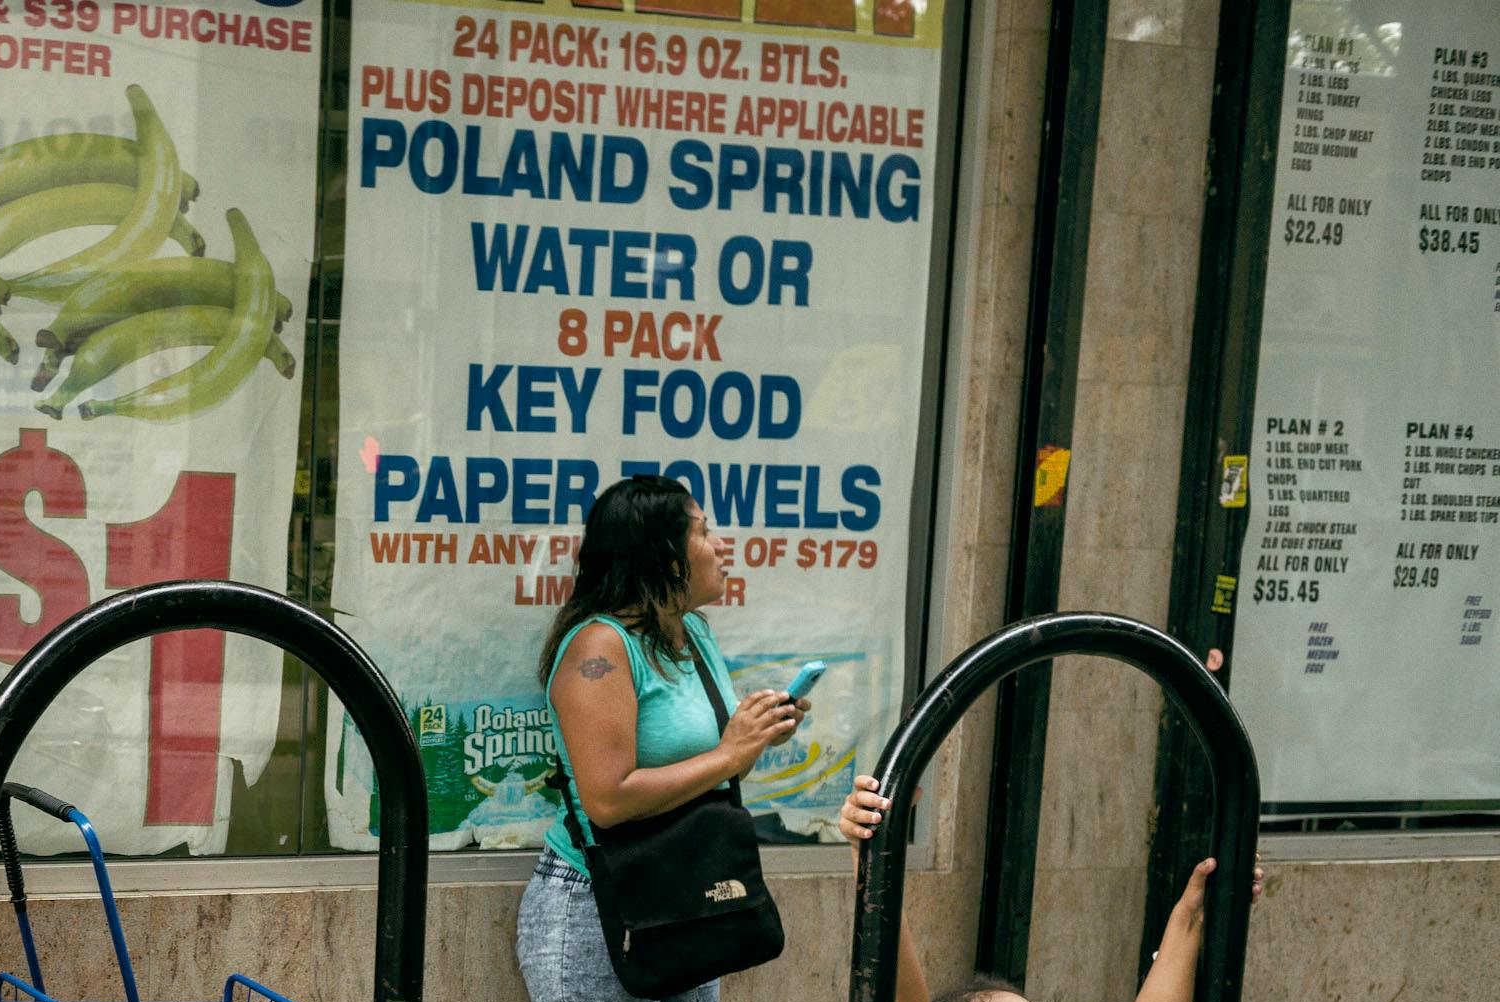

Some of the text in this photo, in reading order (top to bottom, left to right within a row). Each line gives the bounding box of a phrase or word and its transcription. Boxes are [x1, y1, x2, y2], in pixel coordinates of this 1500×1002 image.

[23, 0, 100, 33] $39
[112, 2, 313, 53] PURCHASE
[453, 15, 498, 59] 24
[509, 20, 608, 65] PACK:
[619, 31, 686, 76] 16.9
[698, 36, 750, 81] OZ.
[759, 40, 847, 89] BTLS.
[1434, 47, 1488, 69] PLAN #3
[1300, 73, 1306, 85] 2
[1328, 77, 1349, 90] LEGS
[1298, 90, 1304, 102] 2
[1327, 94, 1361, 108] TURKEY
[1431, 86, 1469, 100] CHICKEN
[361, 65, 925, 149] PLUS DEPOSIT WHERE APPLICABLE
[1297, 107, 1324, 121] WINGS
[1429, 102, 1436, 115] 2
[1295, 124, 1301, 136] 2
[1323, 127, 1347, 140] CHOP
[1349, 130, 1374, 142] MEAT
[1425, 135, 1431, 148] 2
[1293, 141, 1358, 158] DOZEN MEDIUM
[359, 116, 649, 205] POLAND
[668, 138, 923, 223] SPRING
[1291, 158, 1312, 171] EGGS
[1421, 169, 1452, 182] CHOPS
[1287, 194, 1372, 216] ALL FOR ONLY
[1420, 203, 1441, 220] ALL
[1446, 205, 1468, 223] FOR
[1285, 215, 1343, 246] $22.49
[1419, 225, 1480, 254] $38.45
[470, 221, 813, 307] WATER OR
[557, 308, 724, 363] 8 PACK
[466, 363, 802, 441] KEY FOOD
[1267, 418, 1344, 436] PLAN # 2
[1406, 422, 1474, 441] PLAN #4
[1266, 441, 1349, 455] 3 LBS. CHOP MEAT
[1405, 445, 1411, 457] 2
[1465, 448, 1500, 460] CHICKE
[1266, 458, 1362, 471] 4 LBS. END CUT PORK
[1458, 463, 1486, 476] CHOPS
[1267, 473, 1297, 486] CHOPS
[1403, 477, 1421, 489] CUT
[373, 454, 599, 526] PAPER
[1268, 489, 1350, 504] 5 LBS. QUARTERED
[1401, 493, 1407, 505] 2
[1268, 505, 1289, 517] LEGS
[1274, 521, 1292, 533] LBS.
[1296, 522, 1328, 534] CHUCK
[1329, 523, 1357, 535] STEAK
[370, 532, 458, 565] WITH
[467, 533, 545, 566] ANY
[744, 537, 788, 568] OF
[795, 538, 878, 572] $179
[1281, 537, 1304, 549] CUBE
[1307, 538, 1342, 550] STEAKS
[1396, 543, 1479, 560] ALL FOR ONLY
[1257, 555, 1348, 573] ALL FOR ONLY
[1393, 564, 1439, 588] $29.49
[514, 574, 573, 607] LIM
[1253, 575, 1319, 606] $35.45
[1307, 636, 1334, 647] DOZEN
[423, 706, 444, 723] 24
[464, 726, 557, 775] Spring
